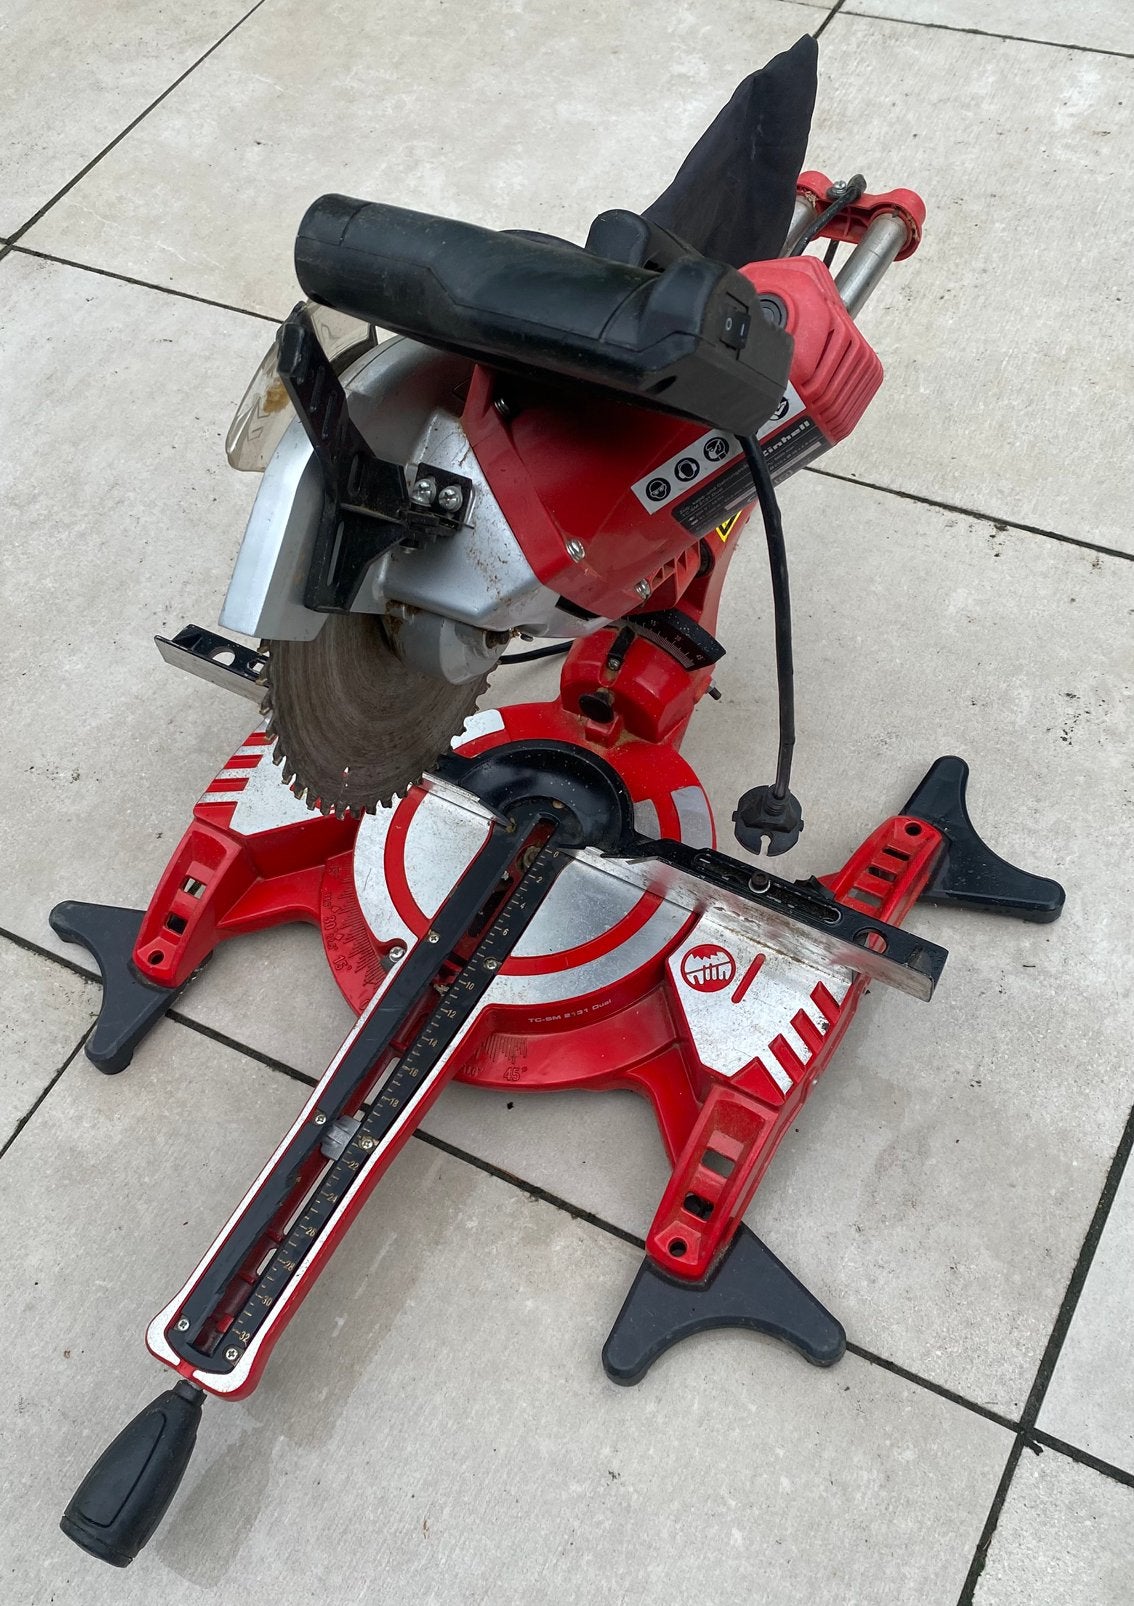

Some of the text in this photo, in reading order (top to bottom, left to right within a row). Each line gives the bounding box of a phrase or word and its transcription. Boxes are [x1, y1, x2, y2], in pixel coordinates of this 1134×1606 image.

[535, 876, 543, 884] 2
[519, 902, 527, 910] 4
[502, 928, 510, 936] 6
[466, 981, 475, 991] 10
[448, 1009, 457, 1019] 12
[528, 998, 612, 1024] TC-SM 2131 Dual
[429, 1038, 438, 1048] 14
[410, 1067, 419, 1078] 16
[390, 1097, 399, 1108] 18
[349, 1161, 360, 1171] 22
[262, 1296, 273, 1307] 30
[239, 1330, 250, 1342] 32
